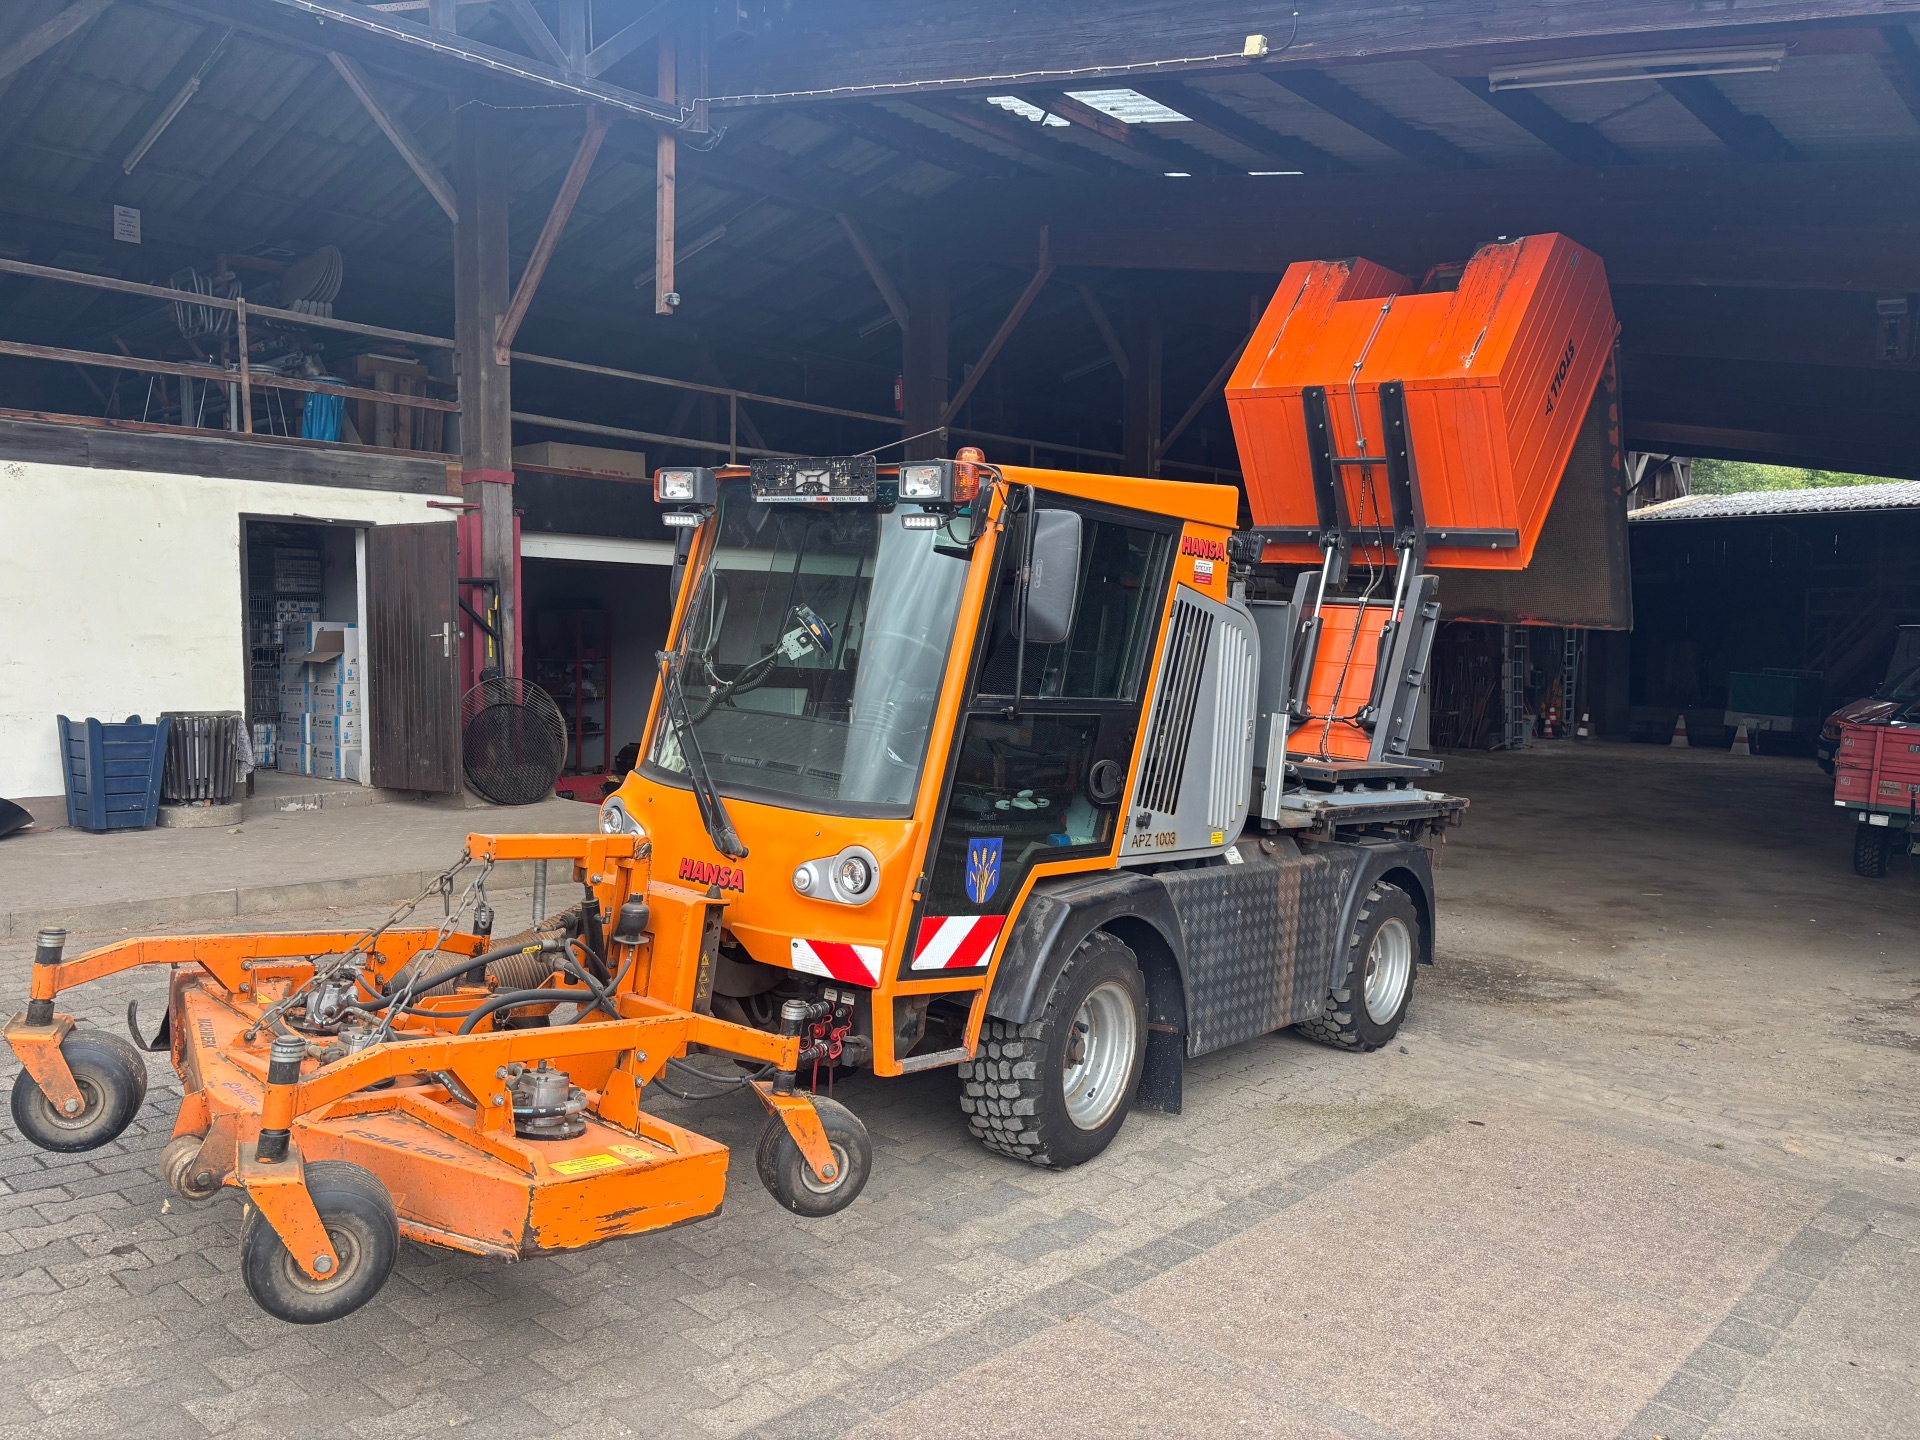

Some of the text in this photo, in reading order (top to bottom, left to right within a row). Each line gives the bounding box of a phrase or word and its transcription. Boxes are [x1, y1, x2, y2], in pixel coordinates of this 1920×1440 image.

[1551, 339, 1575, 398] STOLL
[1182, 536, 1225, 562] HANSA
[980, 811, 997, 821] Stadt
[1132, 831, 1176, 848] APZ 1003
[679, 858, 745, 893] HANSA
[413, 1146, 456, 1160] 150
